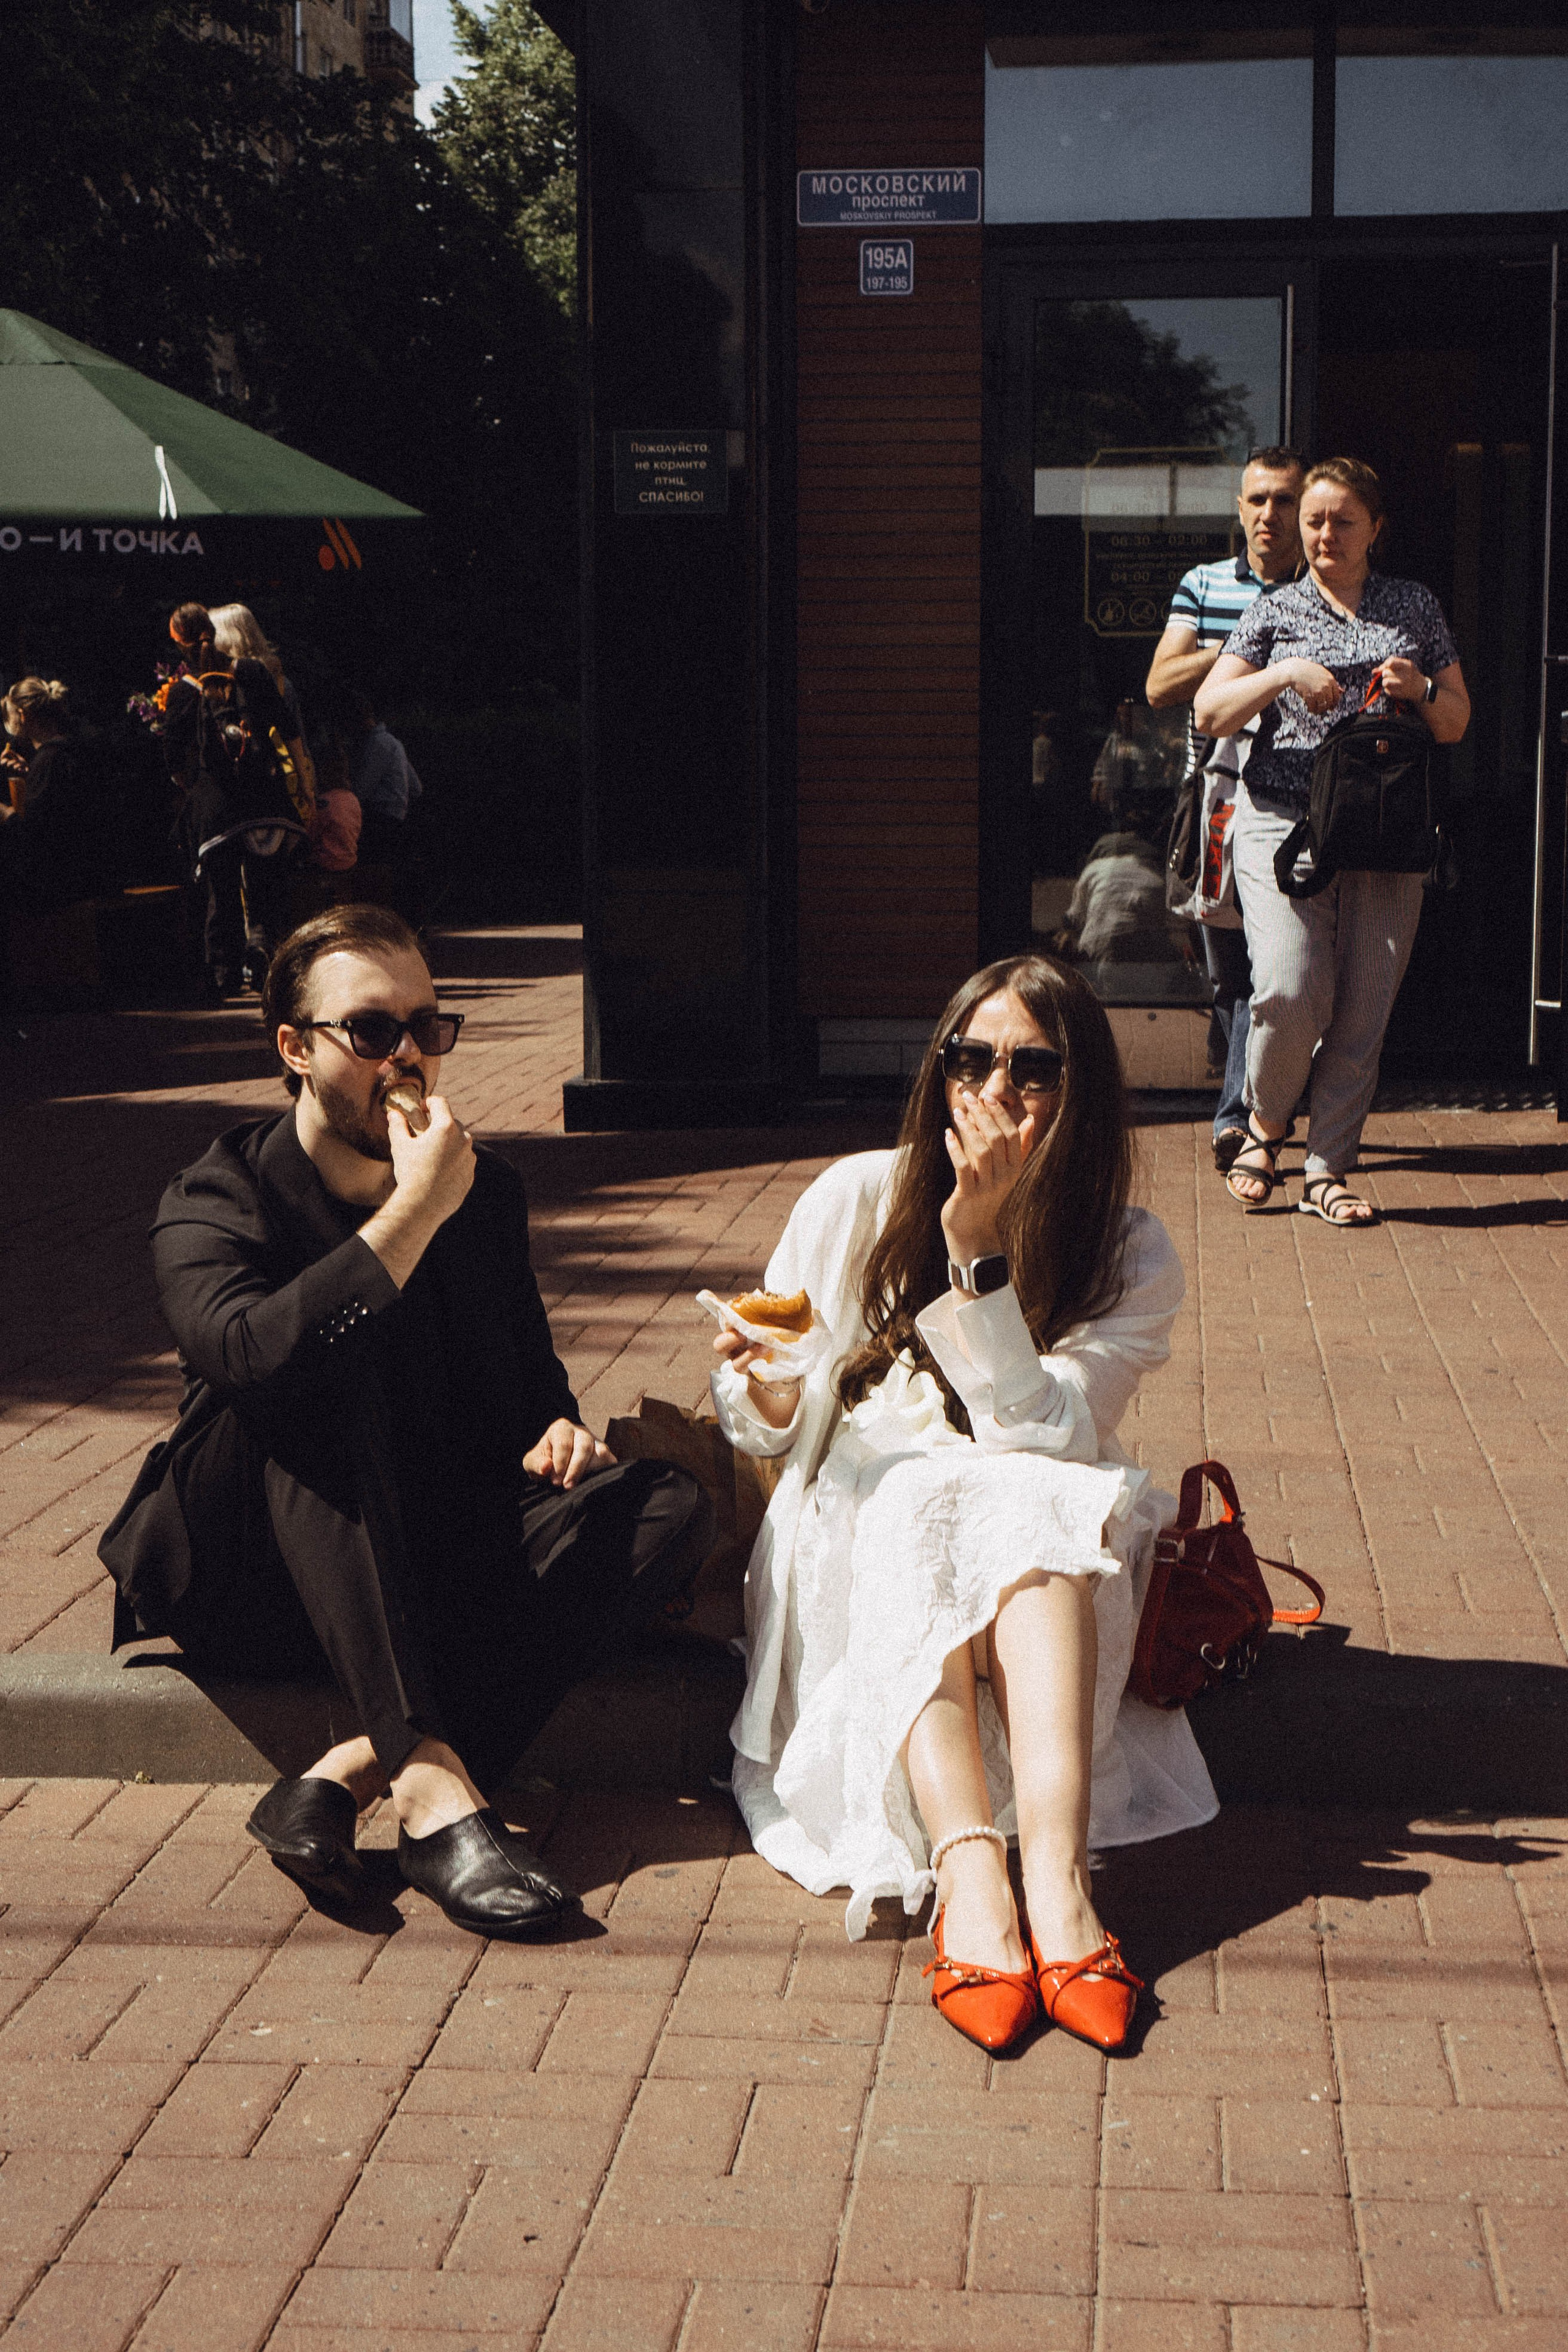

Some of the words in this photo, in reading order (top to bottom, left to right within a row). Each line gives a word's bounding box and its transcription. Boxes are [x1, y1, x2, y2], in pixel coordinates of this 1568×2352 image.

[812, 174, 967, 194] МОСКОВСКИЙ
[852, 195, 925, 211] проспект
[840, 211, 891, 221] MOSKOVSKIY
[894, 210, 937, 219] PROSPEKT
[865, 247, 908, 269] 195А
[866, 276, 908, 289] 197-195
[635, 461, 649, 470] не
[654, 460, 707, 472] кормите
[639, 491, 704, 503] СПАСИБО!
[60, 527, 81, 551] И
[92, 528, 204, 554] ТОЧКА
